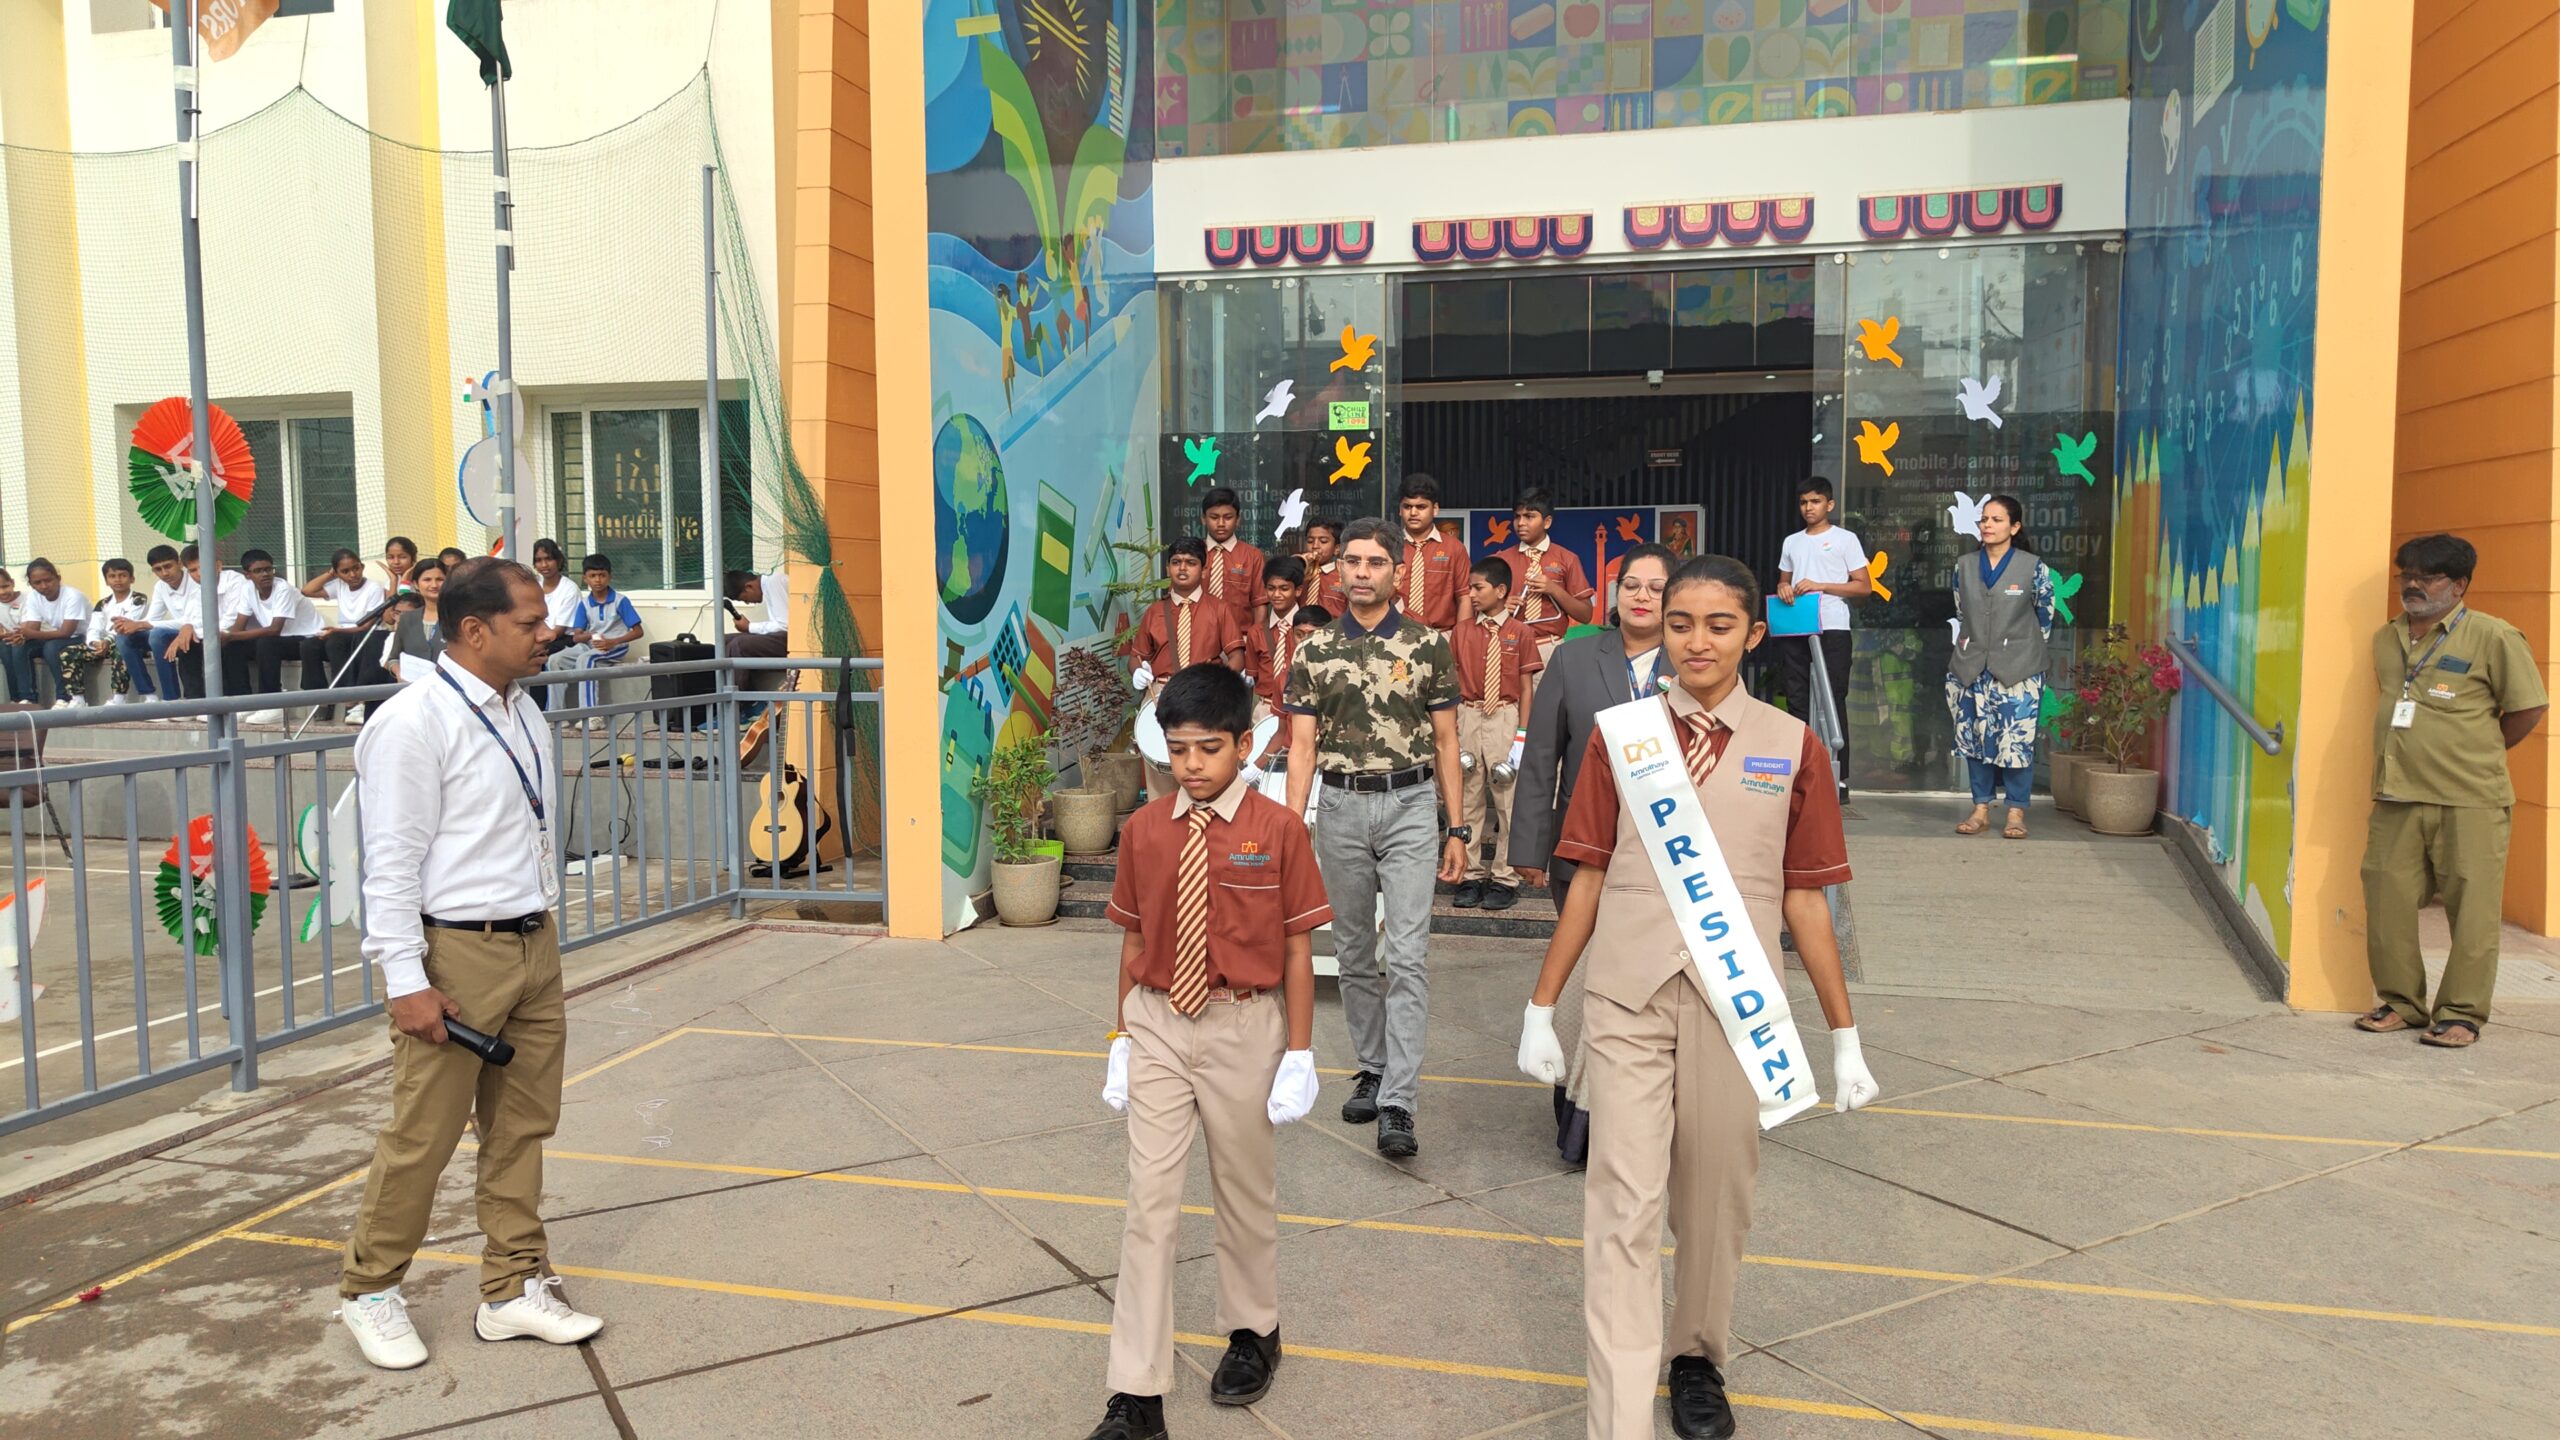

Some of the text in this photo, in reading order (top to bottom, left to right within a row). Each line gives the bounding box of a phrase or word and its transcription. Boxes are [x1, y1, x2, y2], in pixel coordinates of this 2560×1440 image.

[2291, 231, 2303, 297] 6
[2259, 263, 2266, 301] 9
[2233, 286, 2242, 335] 5
[2269, 280, 2278, 327] 6
[2162, 327, 2172, 385] 3
[2187, 399, 2196, 453] 6
[2204, 391, 2213, 441] 8
[1894, 454, 1948, 470] mobile
[1951, 454, 2020, 471] learning
[1936, 474, 2045, 488] blended learning
[1239, 488, 1290, 507] rogres
[1239, 506, 1277, 520] rowth
[1305, 502, 1352, 515] demics
[2030, 530, 2102, 556] nology
[1630, 760, 1670, 779] Amruthaya
[1740, 777, 1785, 793] Amruthaya
[1649, 797, 1796, 1101] PRESIDENT
